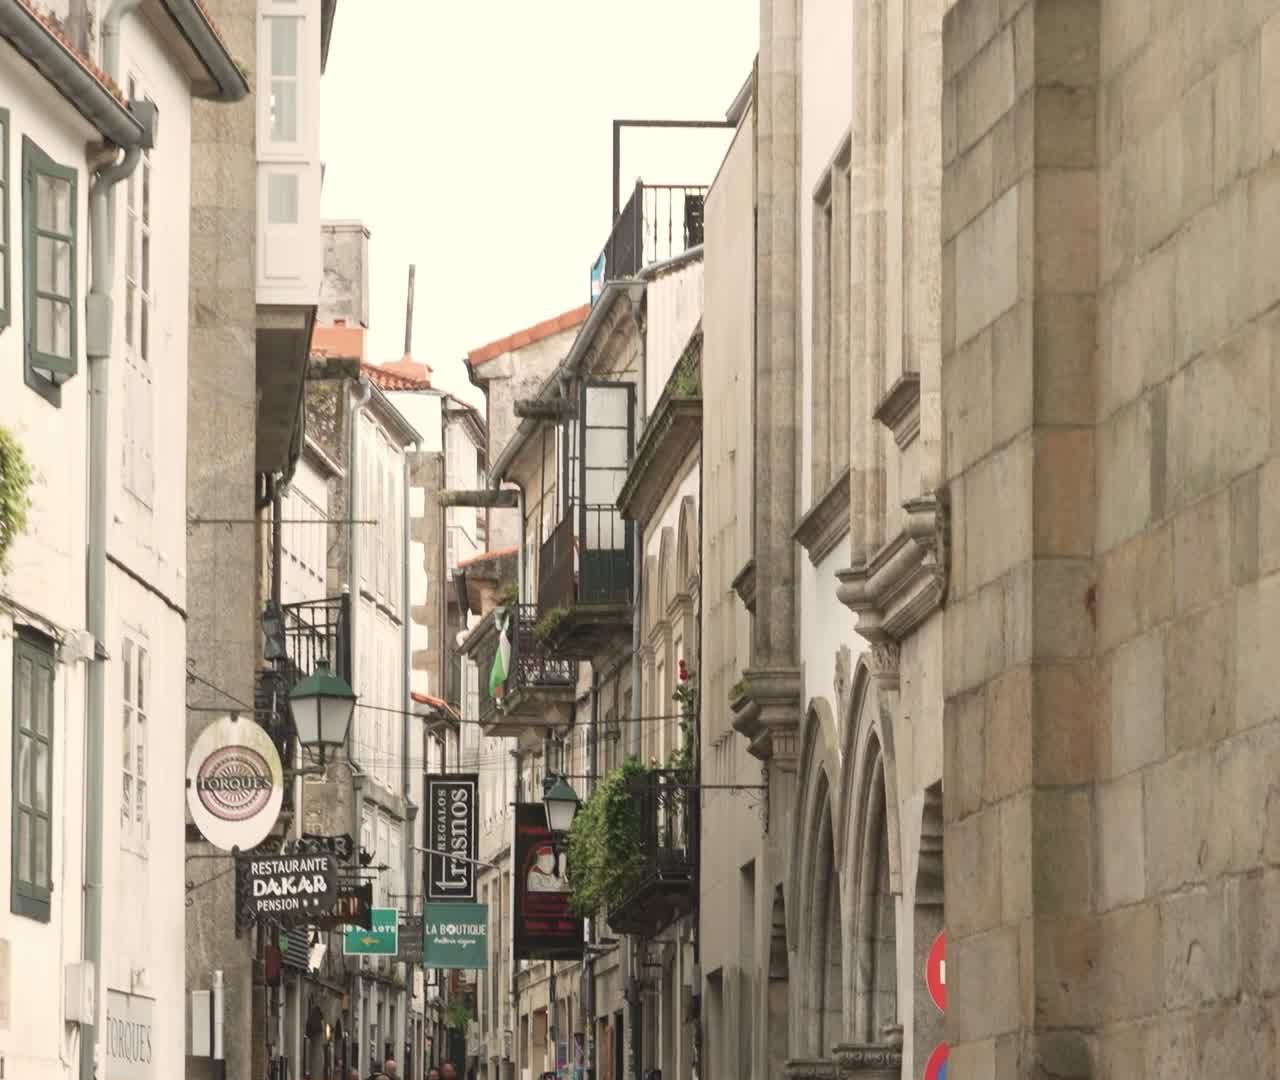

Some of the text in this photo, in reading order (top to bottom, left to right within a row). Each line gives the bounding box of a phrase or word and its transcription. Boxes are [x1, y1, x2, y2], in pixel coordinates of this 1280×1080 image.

[198, 776, 272, 791] TORQUES
[437, 789, 447, 851] REGALOS
[435, 788, 468, 891] trasnos
[251, 857, 328, 875] RESTAURANTE
[253, 874, 327, 897] DAKAR
[257, 898, 299, 911] PENSION
[425, 924, 486, 936] LA BOUTIQUE
[106, 1015, 152, 1064] TORQUES
